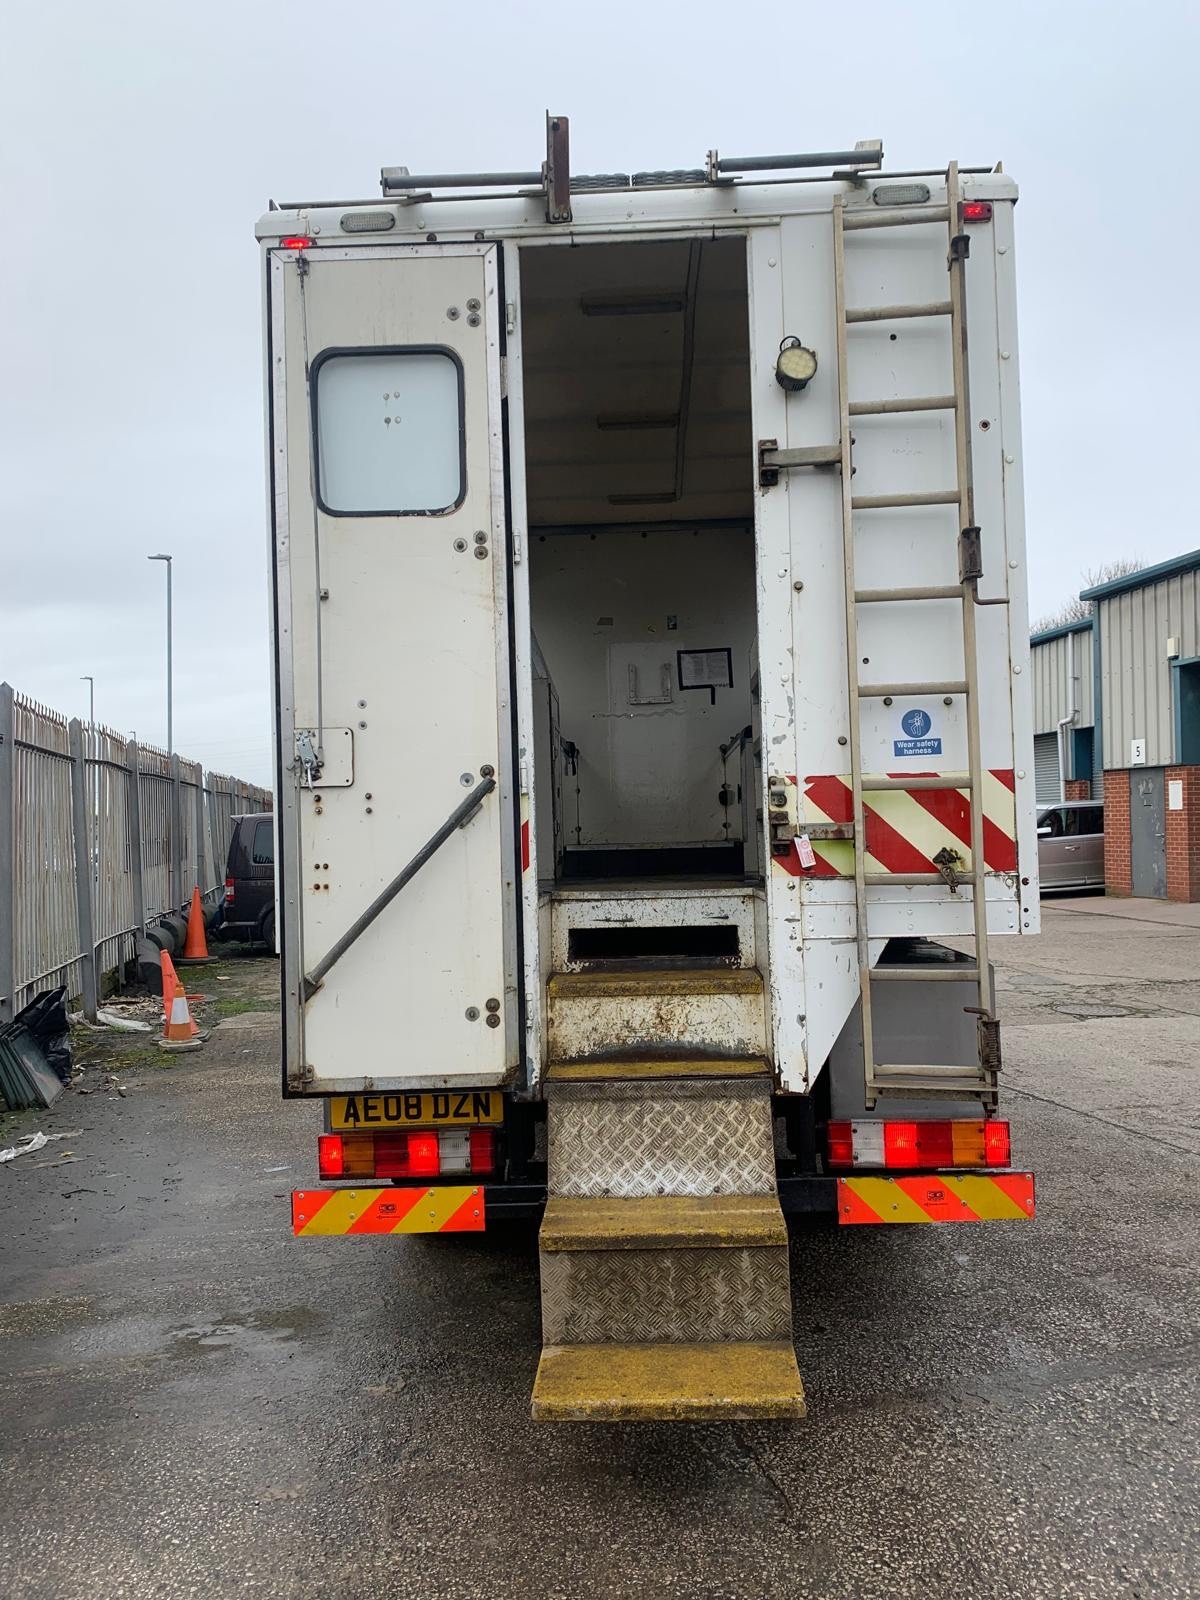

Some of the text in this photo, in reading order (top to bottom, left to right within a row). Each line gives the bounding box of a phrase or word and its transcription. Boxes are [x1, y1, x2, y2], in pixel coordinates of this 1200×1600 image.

[916, 740, 939, 748] safety
[1136, 746, 1141, 757] 5
[344, 1093, 491, 1123] AE08 DZN
